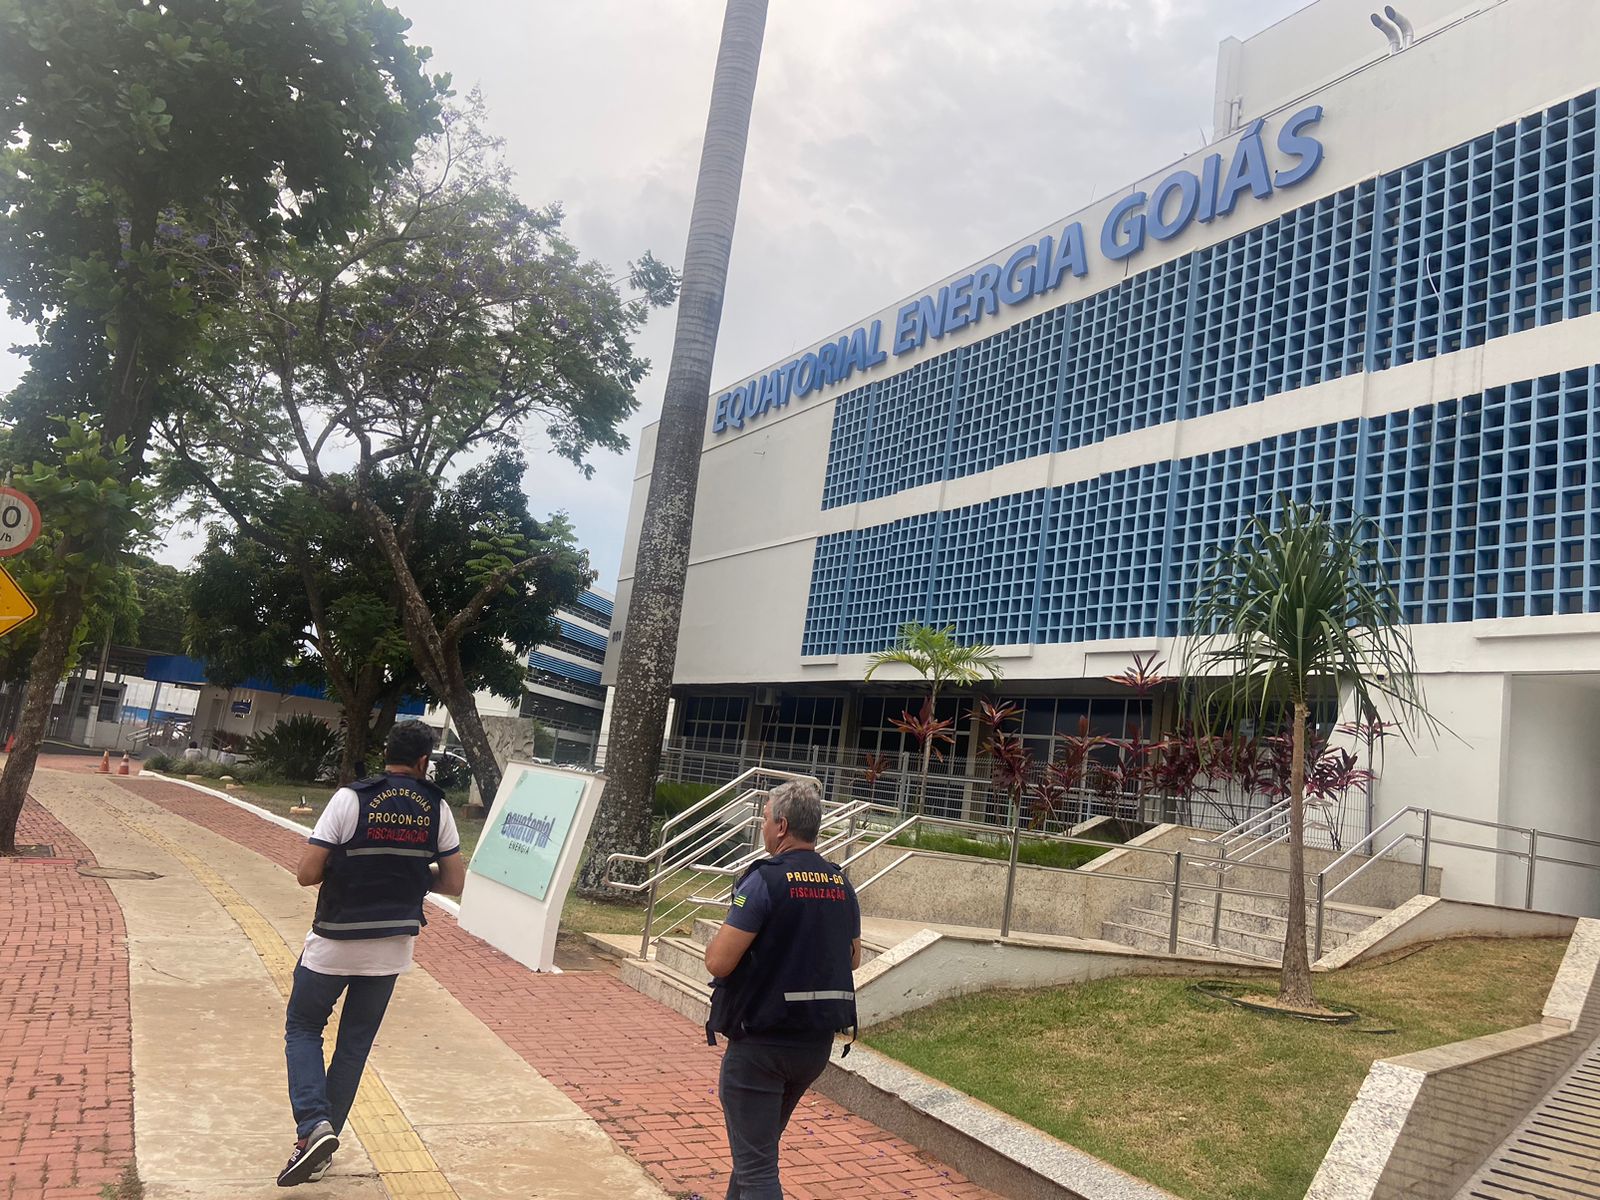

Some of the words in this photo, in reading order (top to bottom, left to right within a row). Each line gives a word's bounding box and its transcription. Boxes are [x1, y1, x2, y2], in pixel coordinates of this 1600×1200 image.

[712, 319, 888, 434] EQUATORIAL
[893, 222, 1088, 356] ENERGIA
[1100, 105, 1324, 261] GOIÁS
[0, 505, 21, 528] 0
[369, 788, 398, 809] ESTADO
[399, 788, 410, 797] DE
[410, 791, 431, 812] GOIÁS
[368, 812, 430, 826] PROCON-GO
[508, 840, 530, 854] ENERGIA
[786, 871, 844, 885] PROCON-GO
